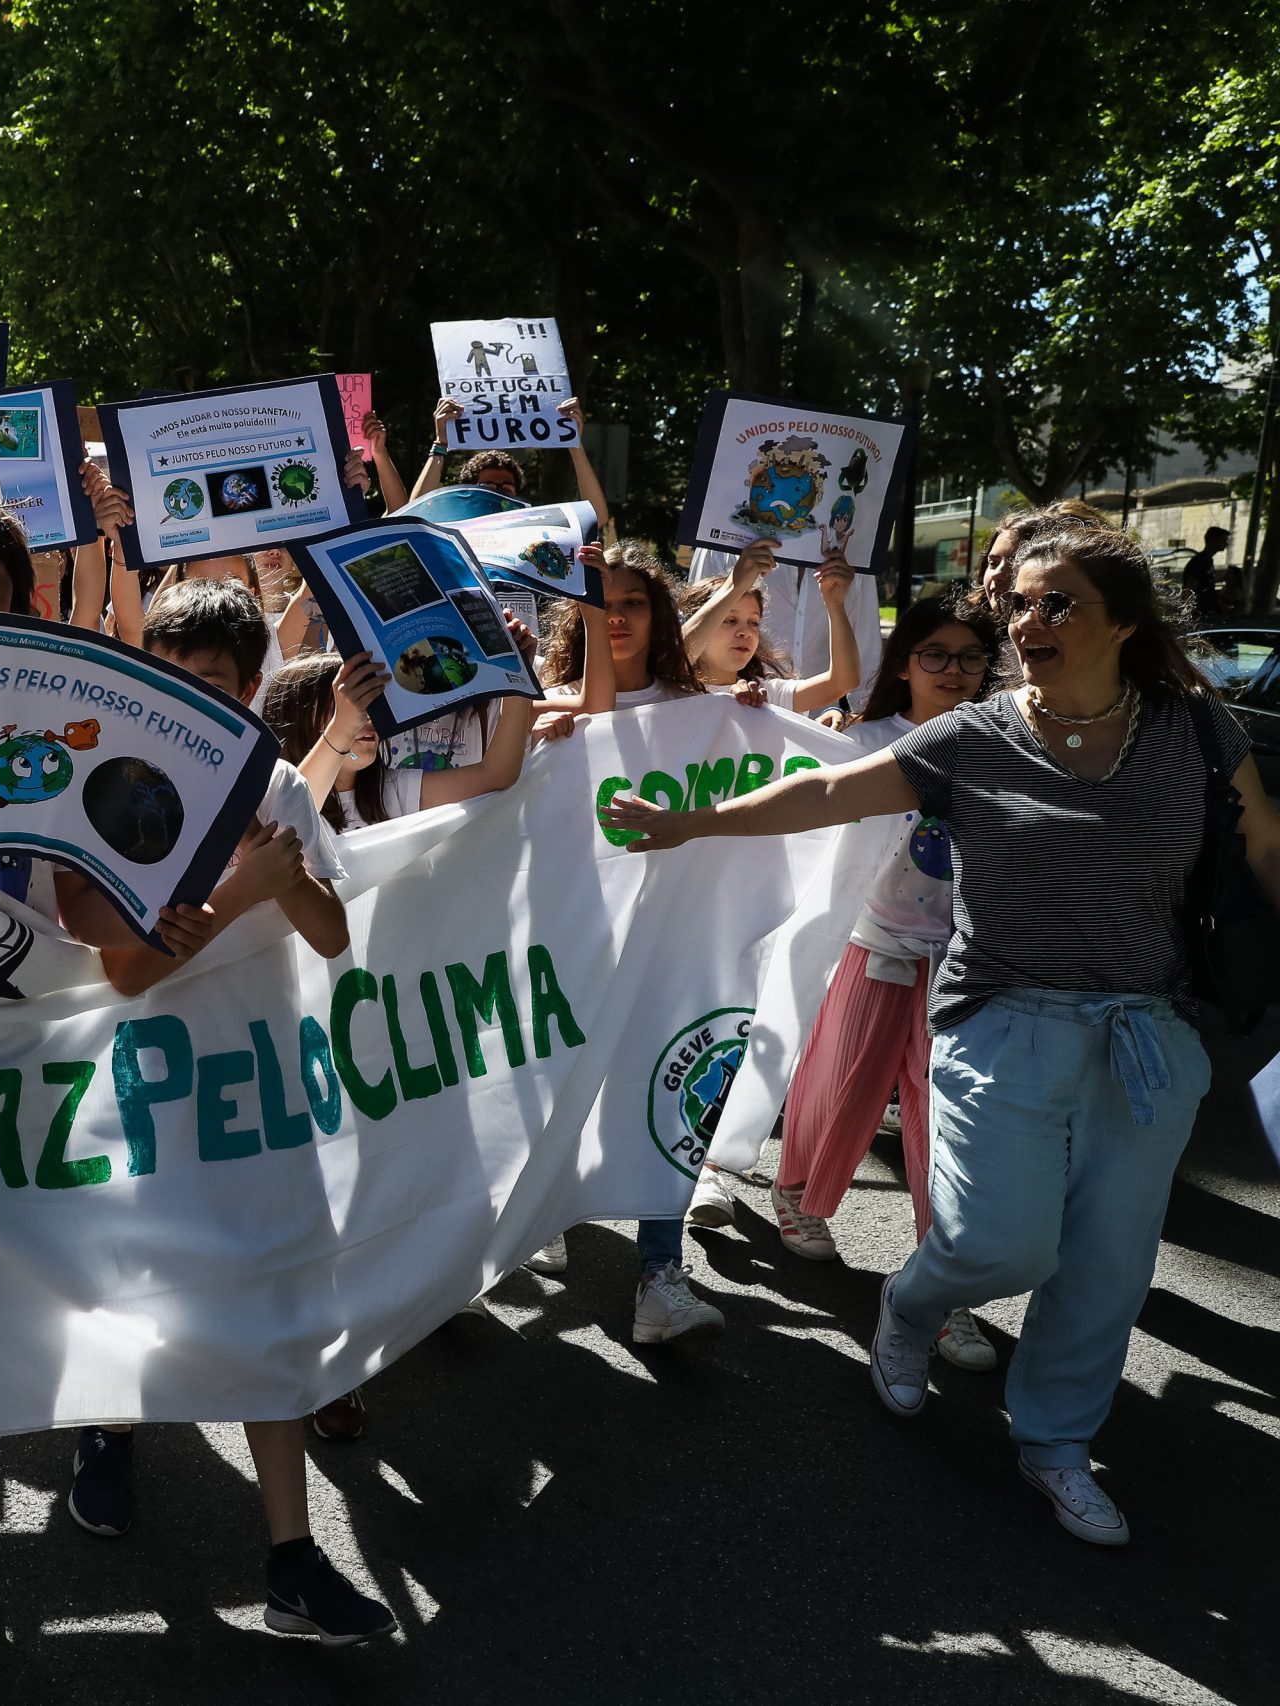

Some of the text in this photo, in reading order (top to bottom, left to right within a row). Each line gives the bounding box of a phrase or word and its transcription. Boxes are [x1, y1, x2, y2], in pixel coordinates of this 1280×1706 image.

[445, 378, 562, 395] PORTUGAL
[472, 394, 541, 415] SEM
[148, 420, 179, 440] VAMOS
[180, 411, 212, 427] AJUDAR
[213, 409, 220, 419] O
[221, 407, 250, 417] NOSSO
[177, 428, 189, 439] Ele
[190, 425, 208, 437] está
[208, 421, 232, 433] muito
[454, 417, 577, 444] FUROS
[735, 422, 785, 445] UNIDOS
[788, 421, 819, 433] PELO
[821, 423, 855, 440] NOSSO
[171, 439, 292, 464] JUNTOS PELO NOSSO FUTURO
[19, 637, 48, 648] MARTIM
[58, 644, 85, 656] FREITAS
[14, 668, 67, 690] PELO
[71, 678, 144, 718] NOSSO
[145, 710, 225, 766] FUTURO
[663, 1027, 715, 1093] GREVE
